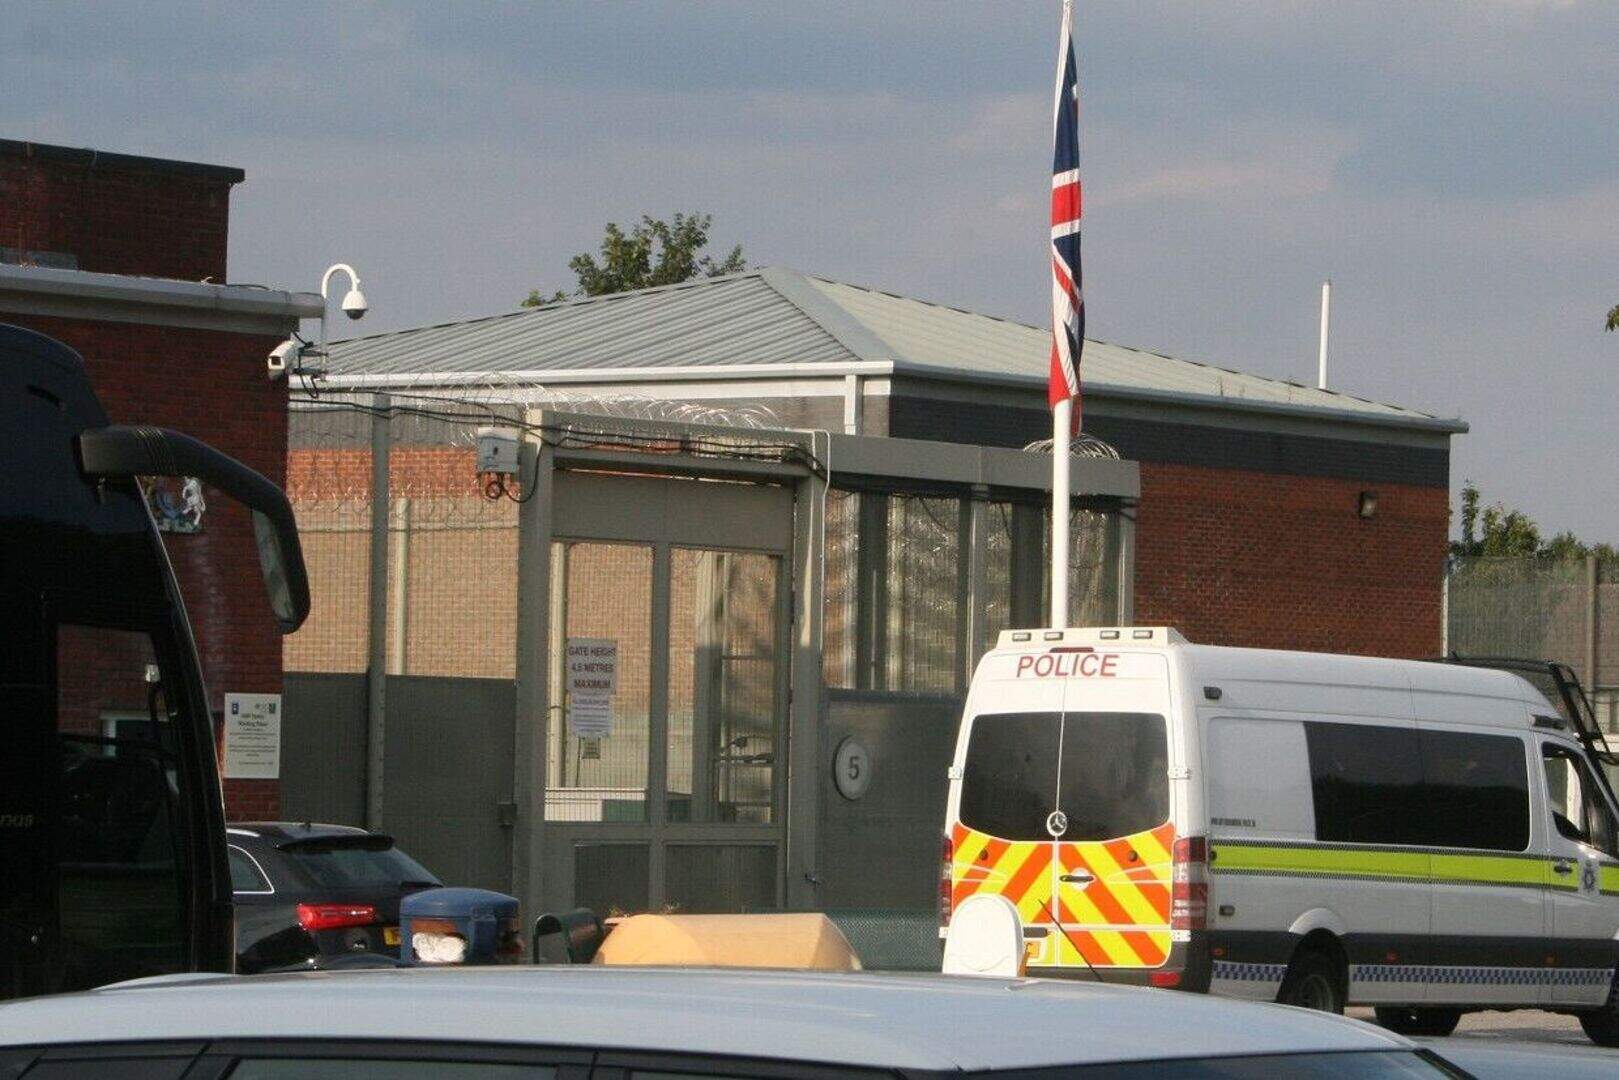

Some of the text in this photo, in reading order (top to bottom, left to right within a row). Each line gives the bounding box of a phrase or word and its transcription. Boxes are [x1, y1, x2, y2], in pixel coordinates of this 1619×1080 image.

[569, 646, 616, 657] GATE HEIGHT
[585, 663, 614, 672] METRES
[1016, 653, 1120, 678] POLICE
[574, 679, 611, 689] MAXIMUM
[848, 755, 861, 780] 5
